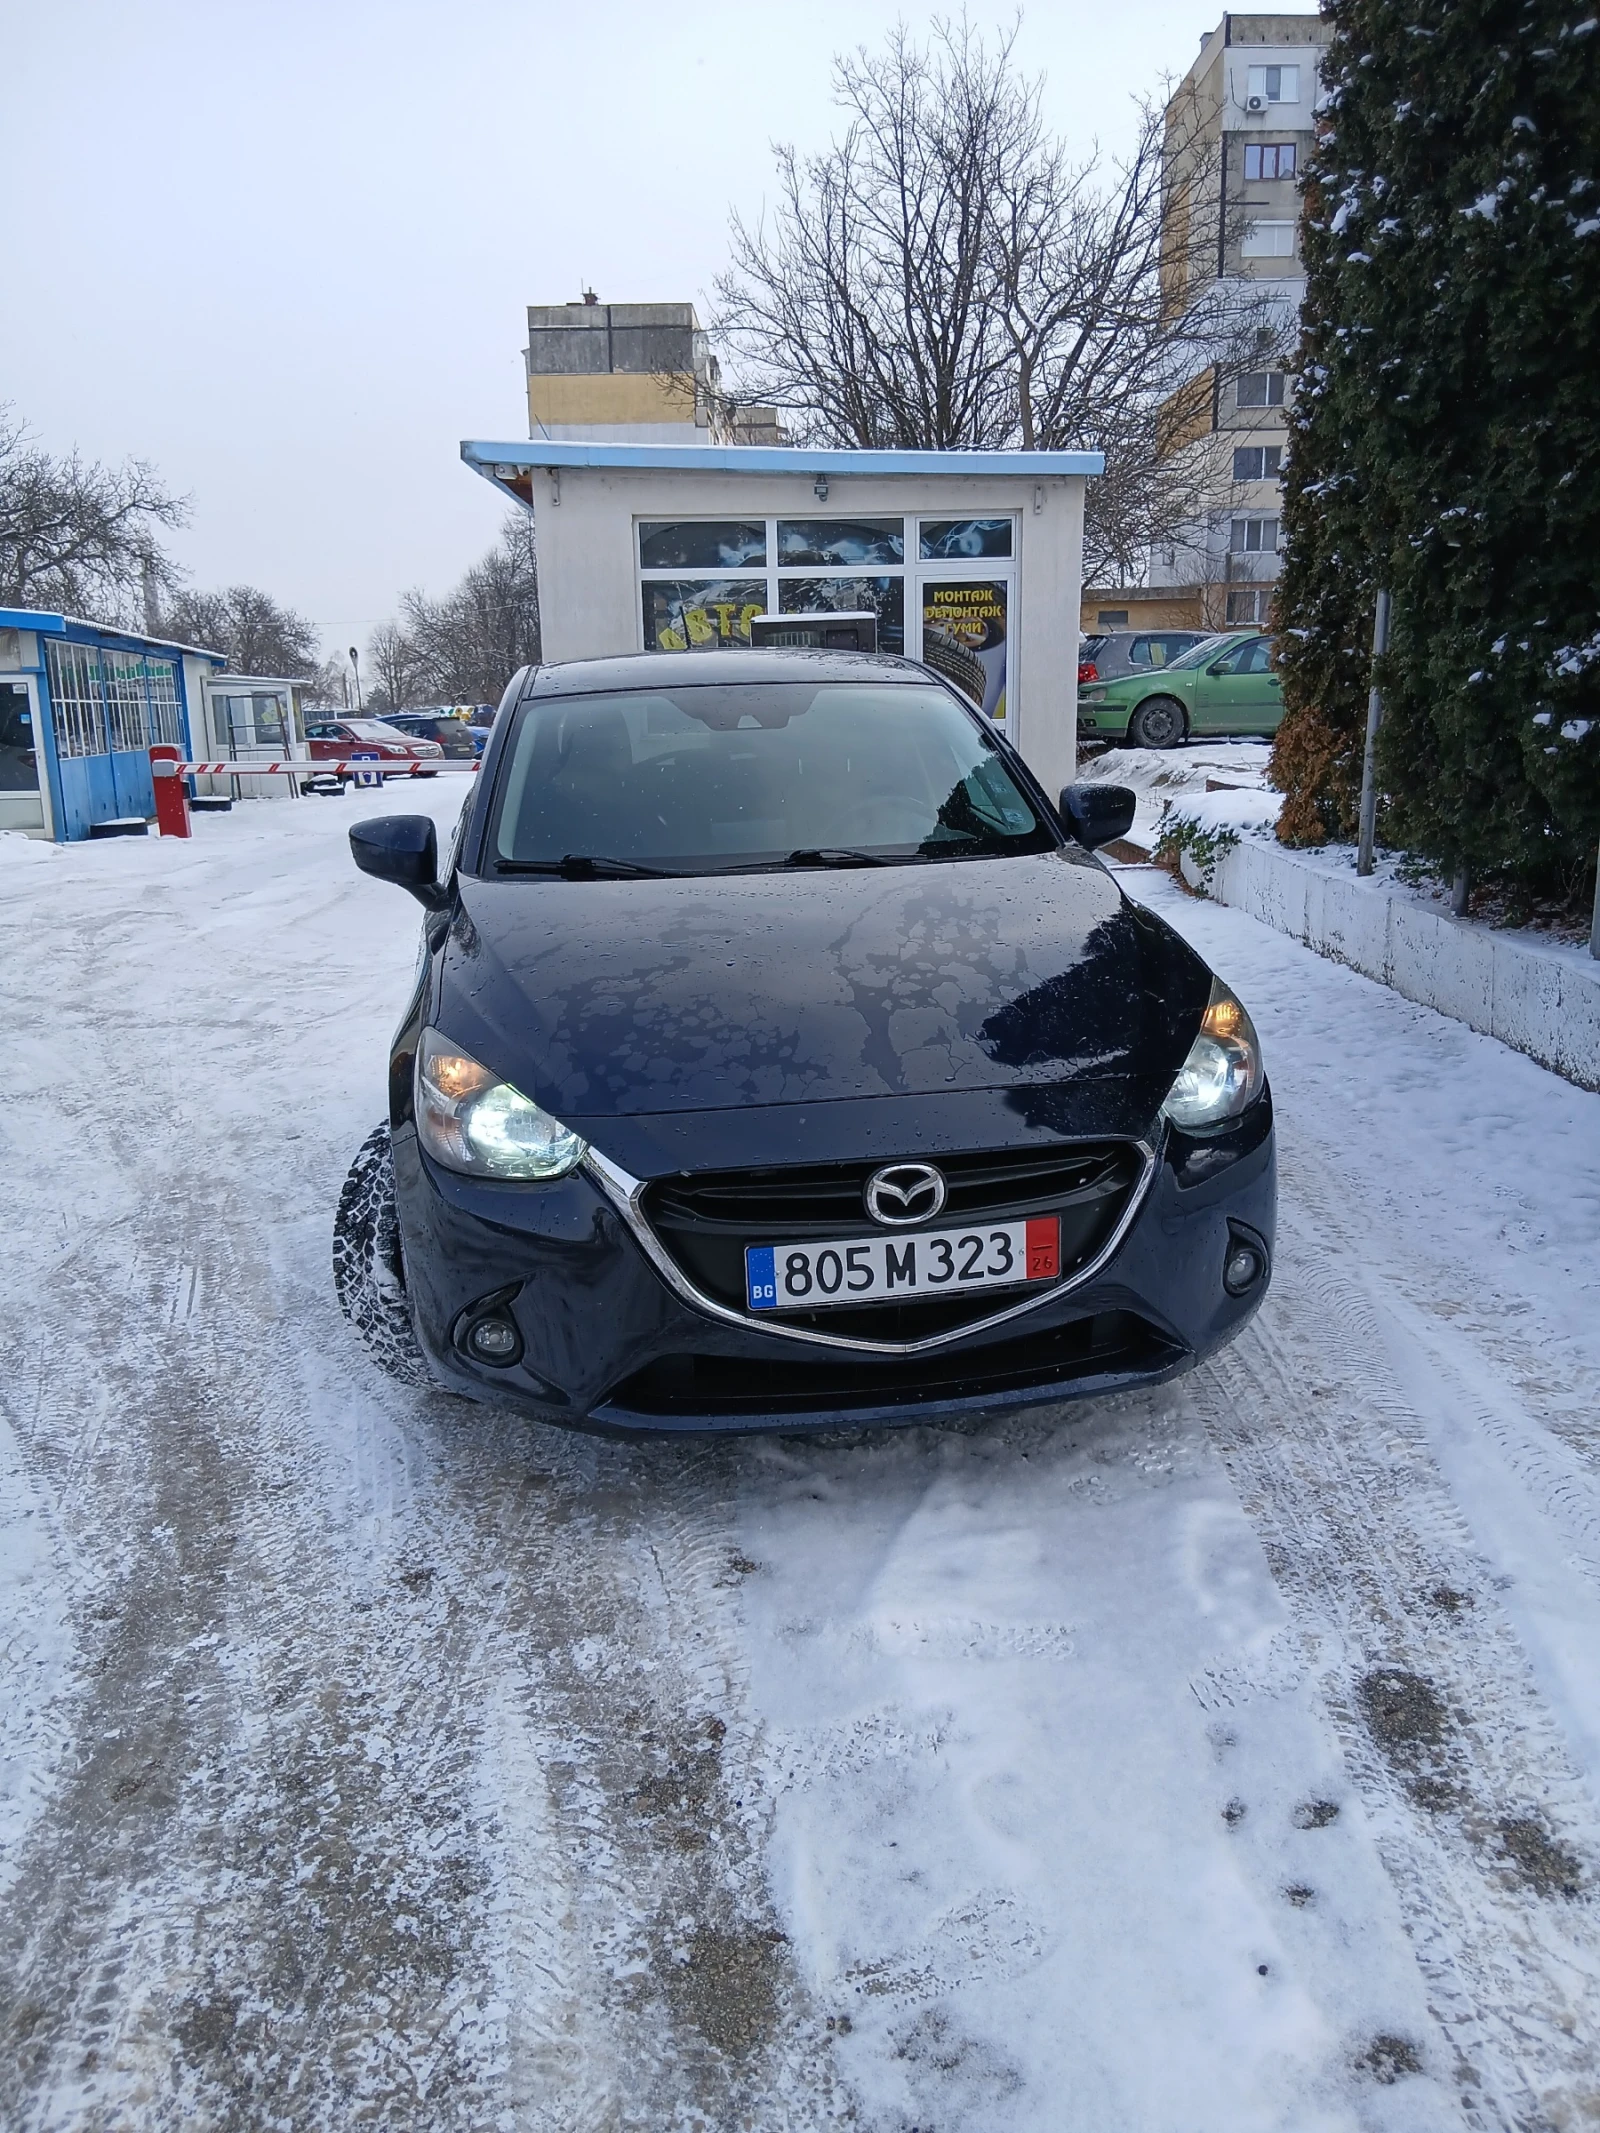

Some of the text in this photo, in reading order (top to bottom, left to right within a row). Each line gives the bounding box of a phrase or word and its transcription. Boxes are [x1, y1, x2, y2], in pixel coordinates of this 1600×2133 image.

[933, 589, 994, 603] МОНТАЖ
[925, 605, 1002, 619] ДЕМОНТАЖ
[946, 622, 982, 635] ГУМИ
[784, 1245, 875, 1297] 805
[927, 1231, 1014, 1284] 323
[1032, 1257, 1053, 1272] 26
[752, 1284, 774, 1299] BG
